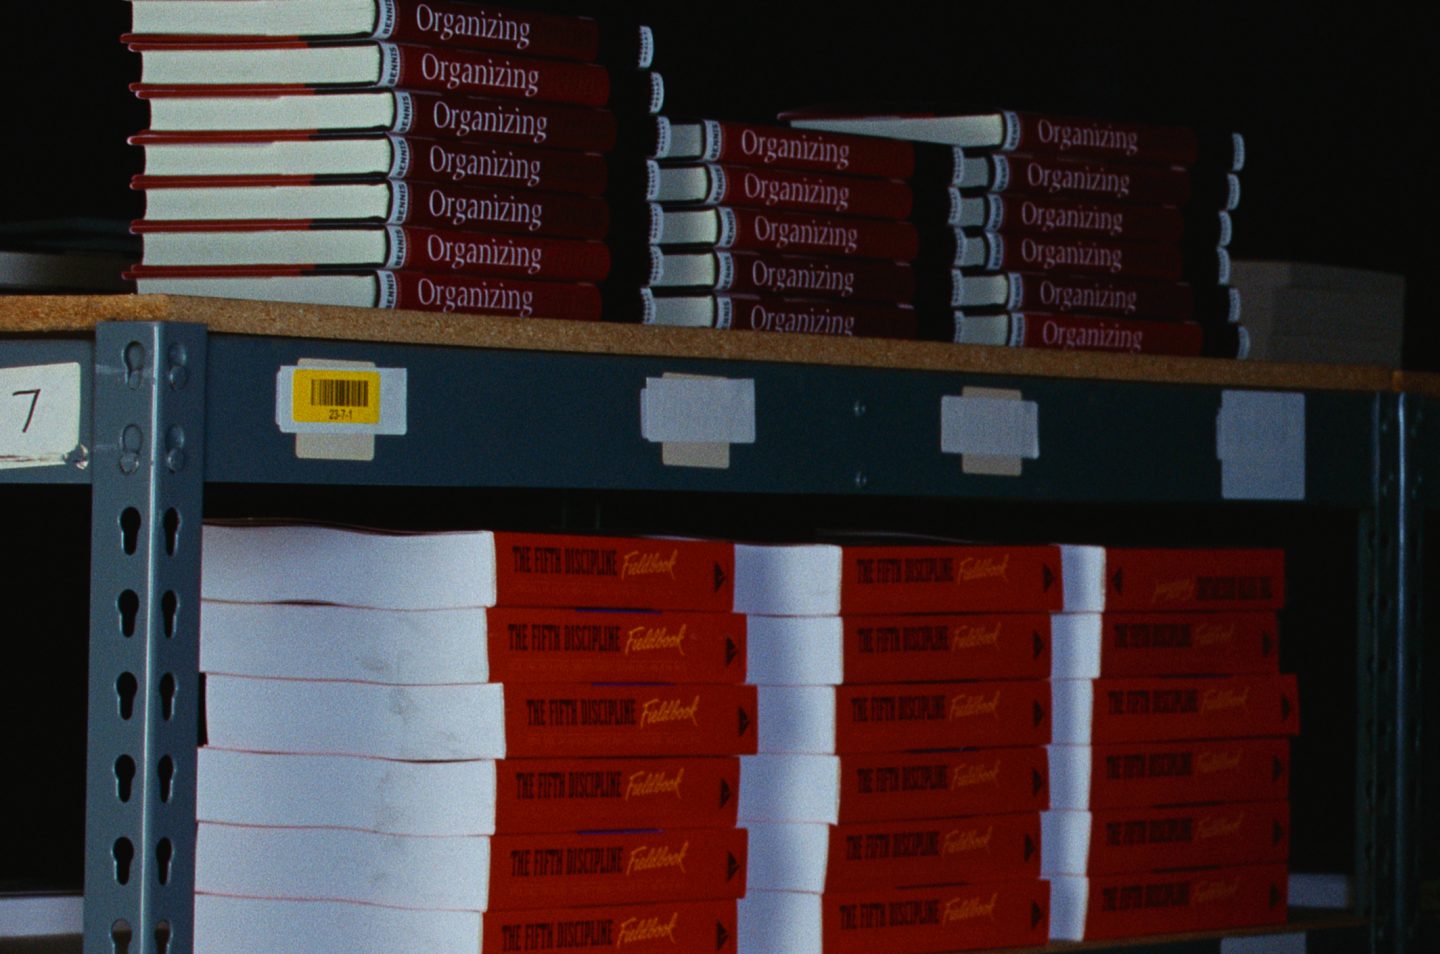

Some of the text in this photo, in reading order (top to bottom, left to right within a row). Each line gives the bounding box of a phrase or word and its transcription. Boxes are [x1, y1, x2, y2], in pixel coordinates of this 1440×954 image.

[416, 4, 530, 49] Organizing
[388, 47, 397, 84] BENNIS
[422, 53, 539, 97] Organizing
[398, 95, 410, 132] BENNIS
[433, 100, 548, 143] Organizing
[741, 128, 850, 170] Organizing
[1037, 119, 1138, 155] Organizing
[429, 145, 541, 187] Organizing
[1027, 161, 1130, 198] Organizing
[396, 184, 406, 221] BENNIS
[429, 189, 543, 231] Organizing
[744, 173, 850, 211] Organizing
[754, 215, 858, 254] Organizing
[1021, 200, 1123, 236] Organizing
[395, 230, 404, 266] BENNIS
[427, 234, 542, 274] Organizing
[1020, 238, 1122, 273] Organizing
[752, 260, 854, 296] Organizing
[417, 278, 533, 317] Organizing
[1039, 279, 1137, 314] Organizing
[751, 304, 855, 336] Organizing
[1042, 320, 1143, 354] Organizing
[12, 388, 41, 433] 7
[329, 409, 353, 420] 23-7-1
[512, 546, 678, 580] THE FIFTH DISCIPLINE Fieldbook
[856, 558, 873, 584] THE
[508, 623, 686, 656] THE FIFTH DISCIPLINE Fieldbook
[857, 627, 873, 654] THE
[526, 695, 700, 729] THE FIFTH DISCIPLINE Fieldbook
[850, 698, 868, 722] THE
[516, 768, 685, 801] THE FIFTH DISCIPLINE Fieldbook
[856, 768, 873, 794] THE
[511, 840, 689, 877] THE FIFTH DISCIPLINE Fieldbook
[846, 835, 862, 860] THE
[502, 912, 678, 952] THE FIFTH DISCIPLINE Fieldbook
[840, 904, 856, 930] THE
